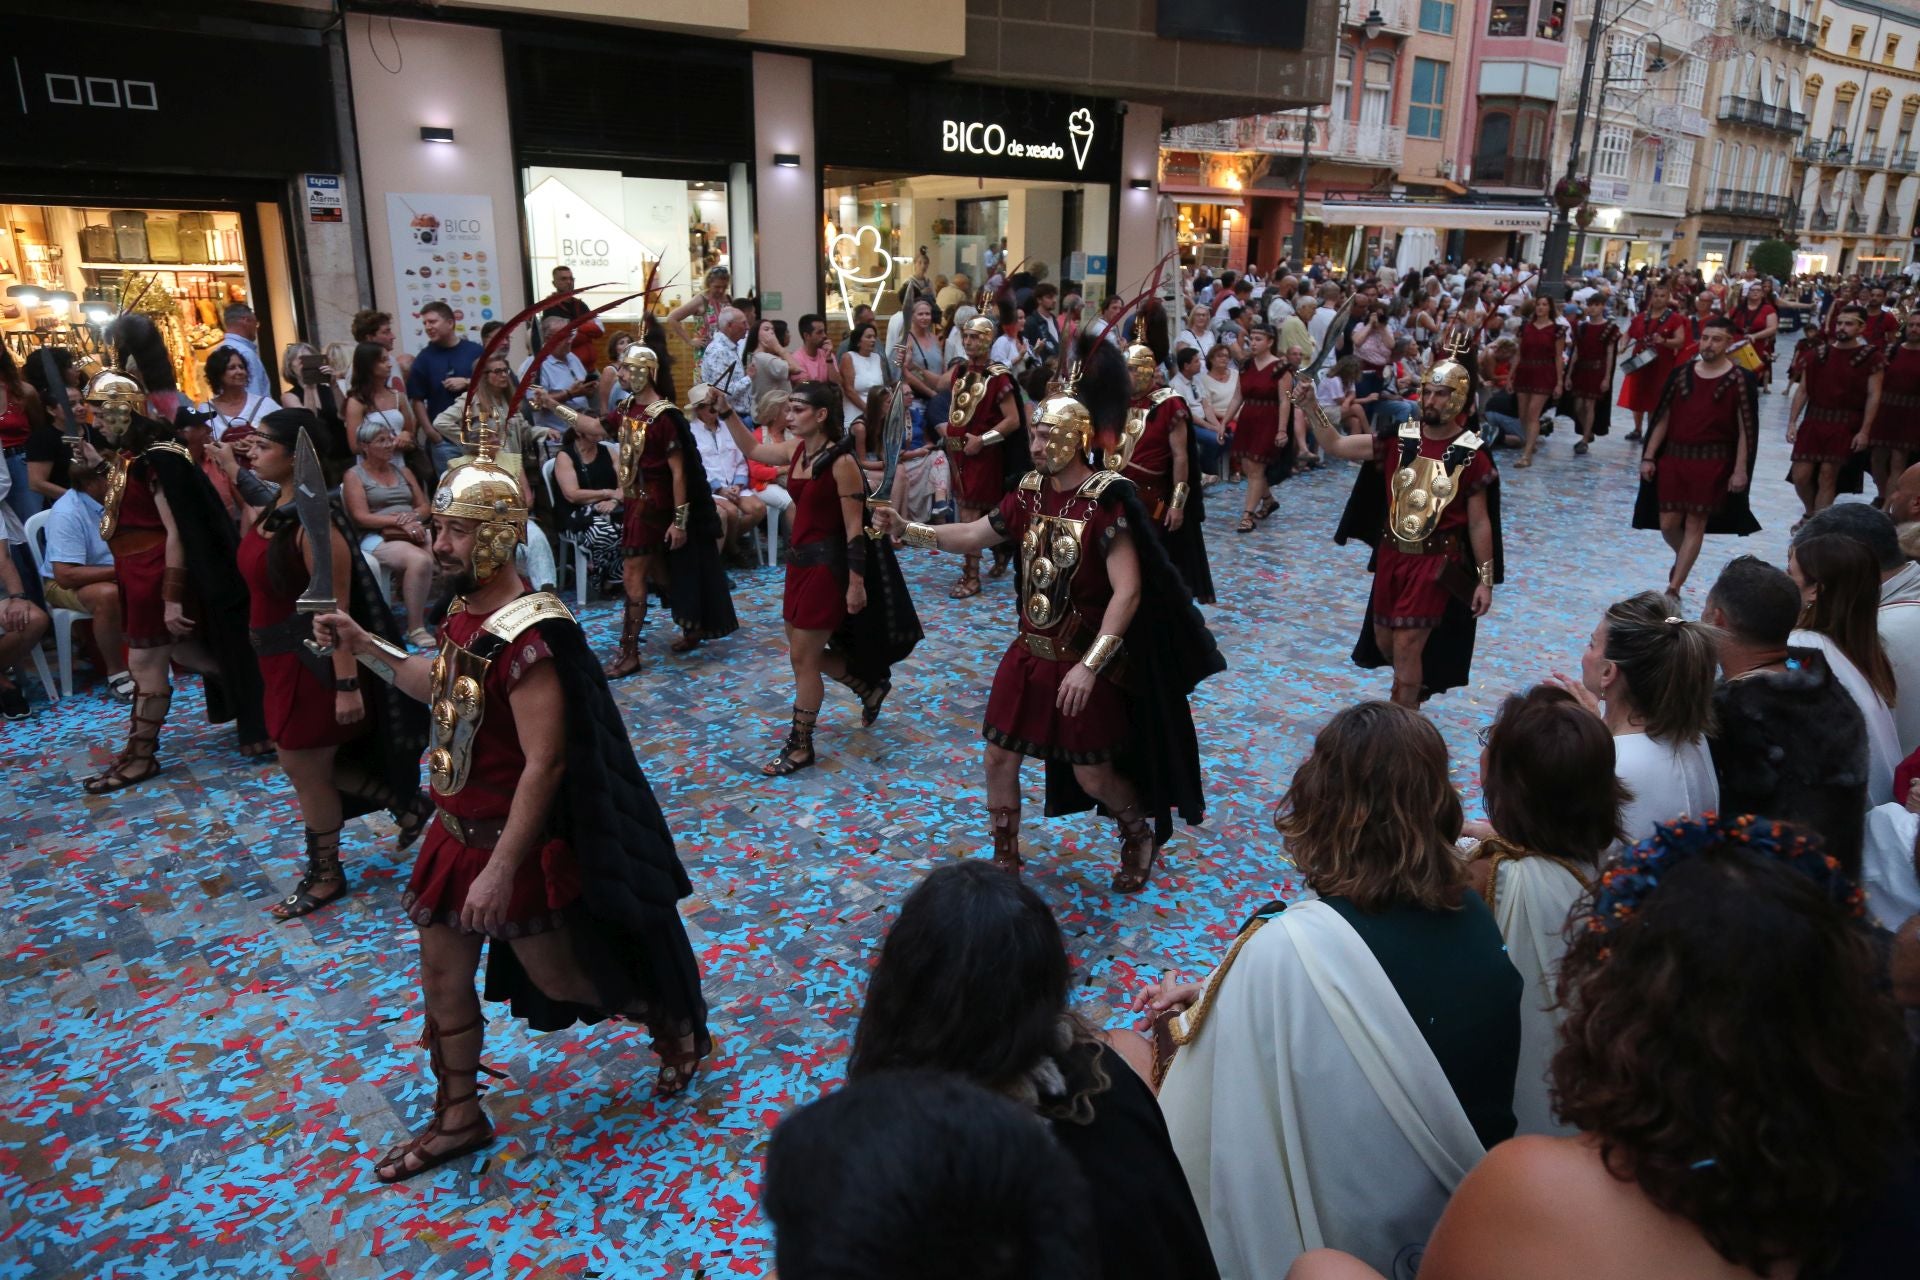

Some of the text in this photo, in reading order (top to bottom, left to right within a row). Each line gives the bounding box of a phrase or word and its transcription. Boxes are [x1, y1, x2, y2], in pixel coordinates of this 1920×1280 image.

[943, 120, 1064, 160] BICO de xeado
[309, 177, 336, 187] tyco
[310, 194, 340, 203] Alarma
[444, 219, 481, 233] BICO
[562, 239, 609, 257] BICO
[564, 257, 609, 267] de xeado
